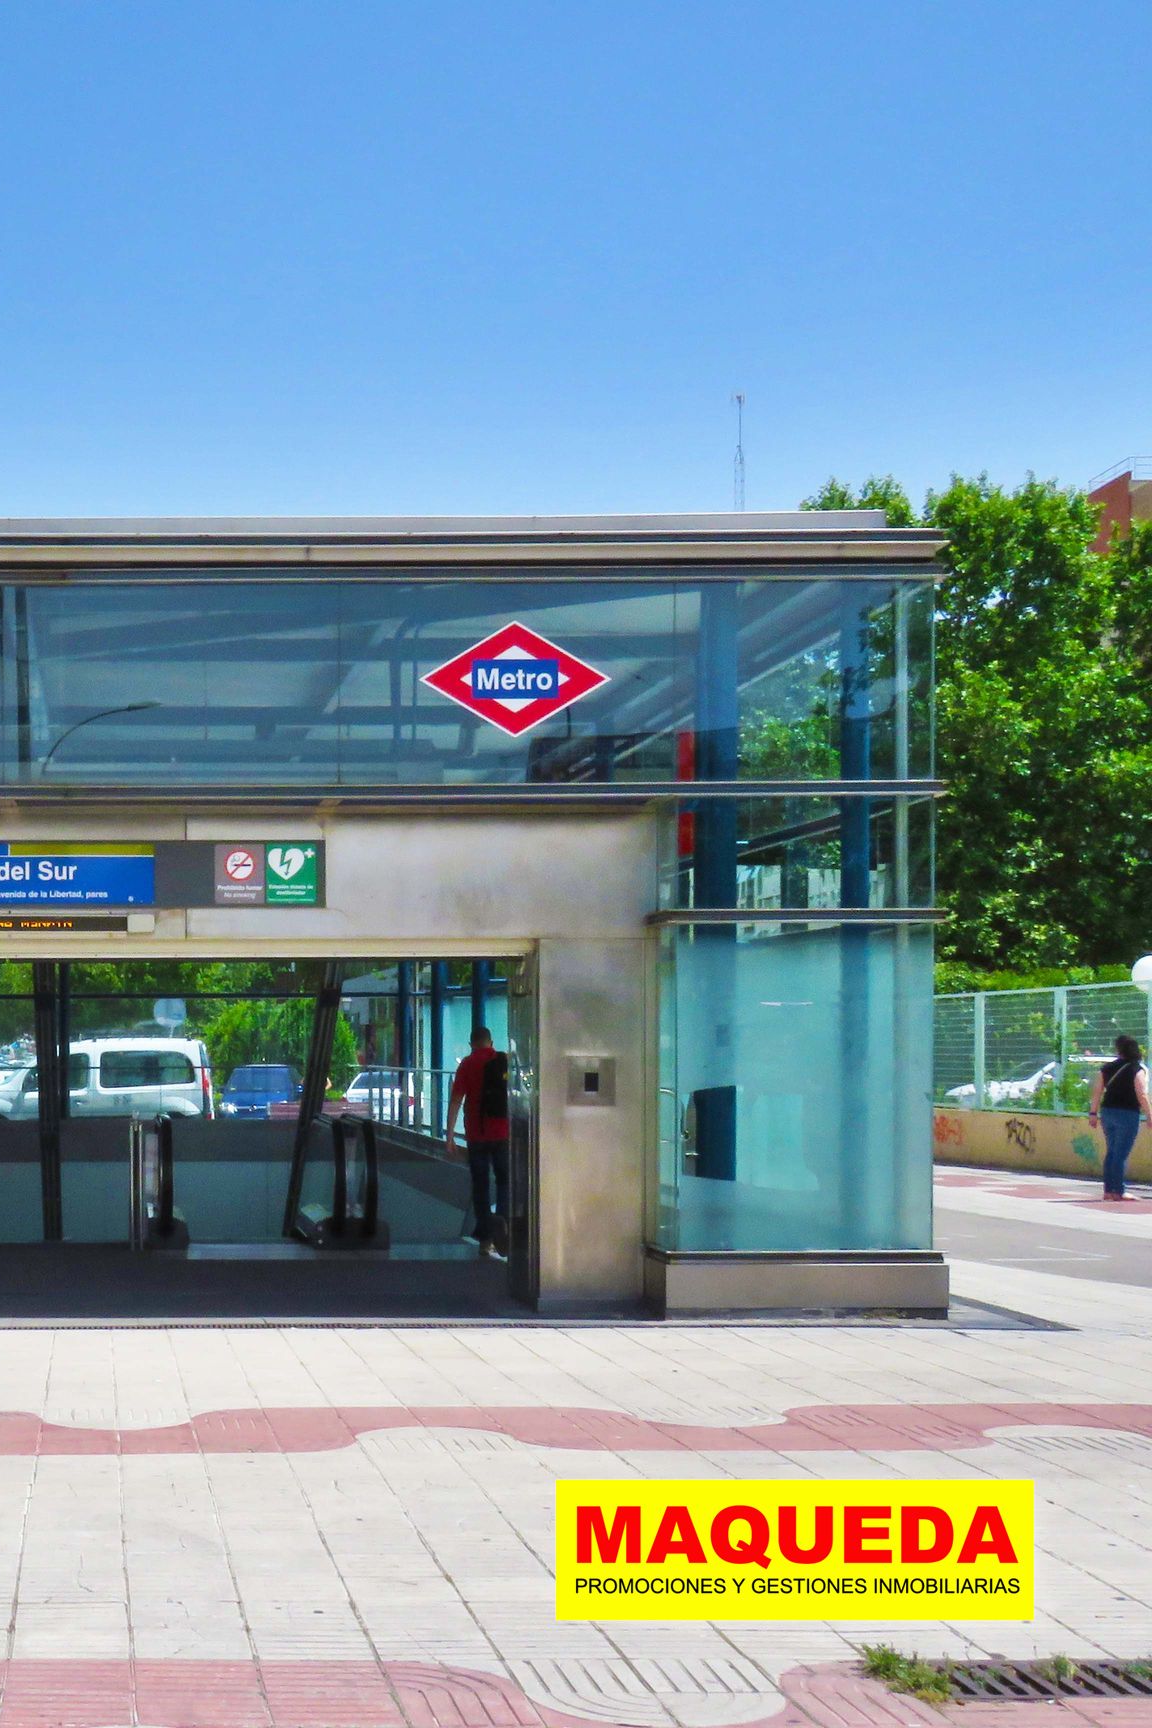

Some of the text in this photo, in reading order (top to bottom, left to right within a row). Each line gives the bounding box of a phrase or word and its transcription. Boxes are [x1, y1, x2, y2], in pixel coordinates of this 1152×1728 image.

[477, 668, 553, 690] Metro
[37, 860, 78, 881] Sur
[28, 890, 39, 899] de
[40, 890, 48, 898] la
[85, 891, 109, 900] pares
